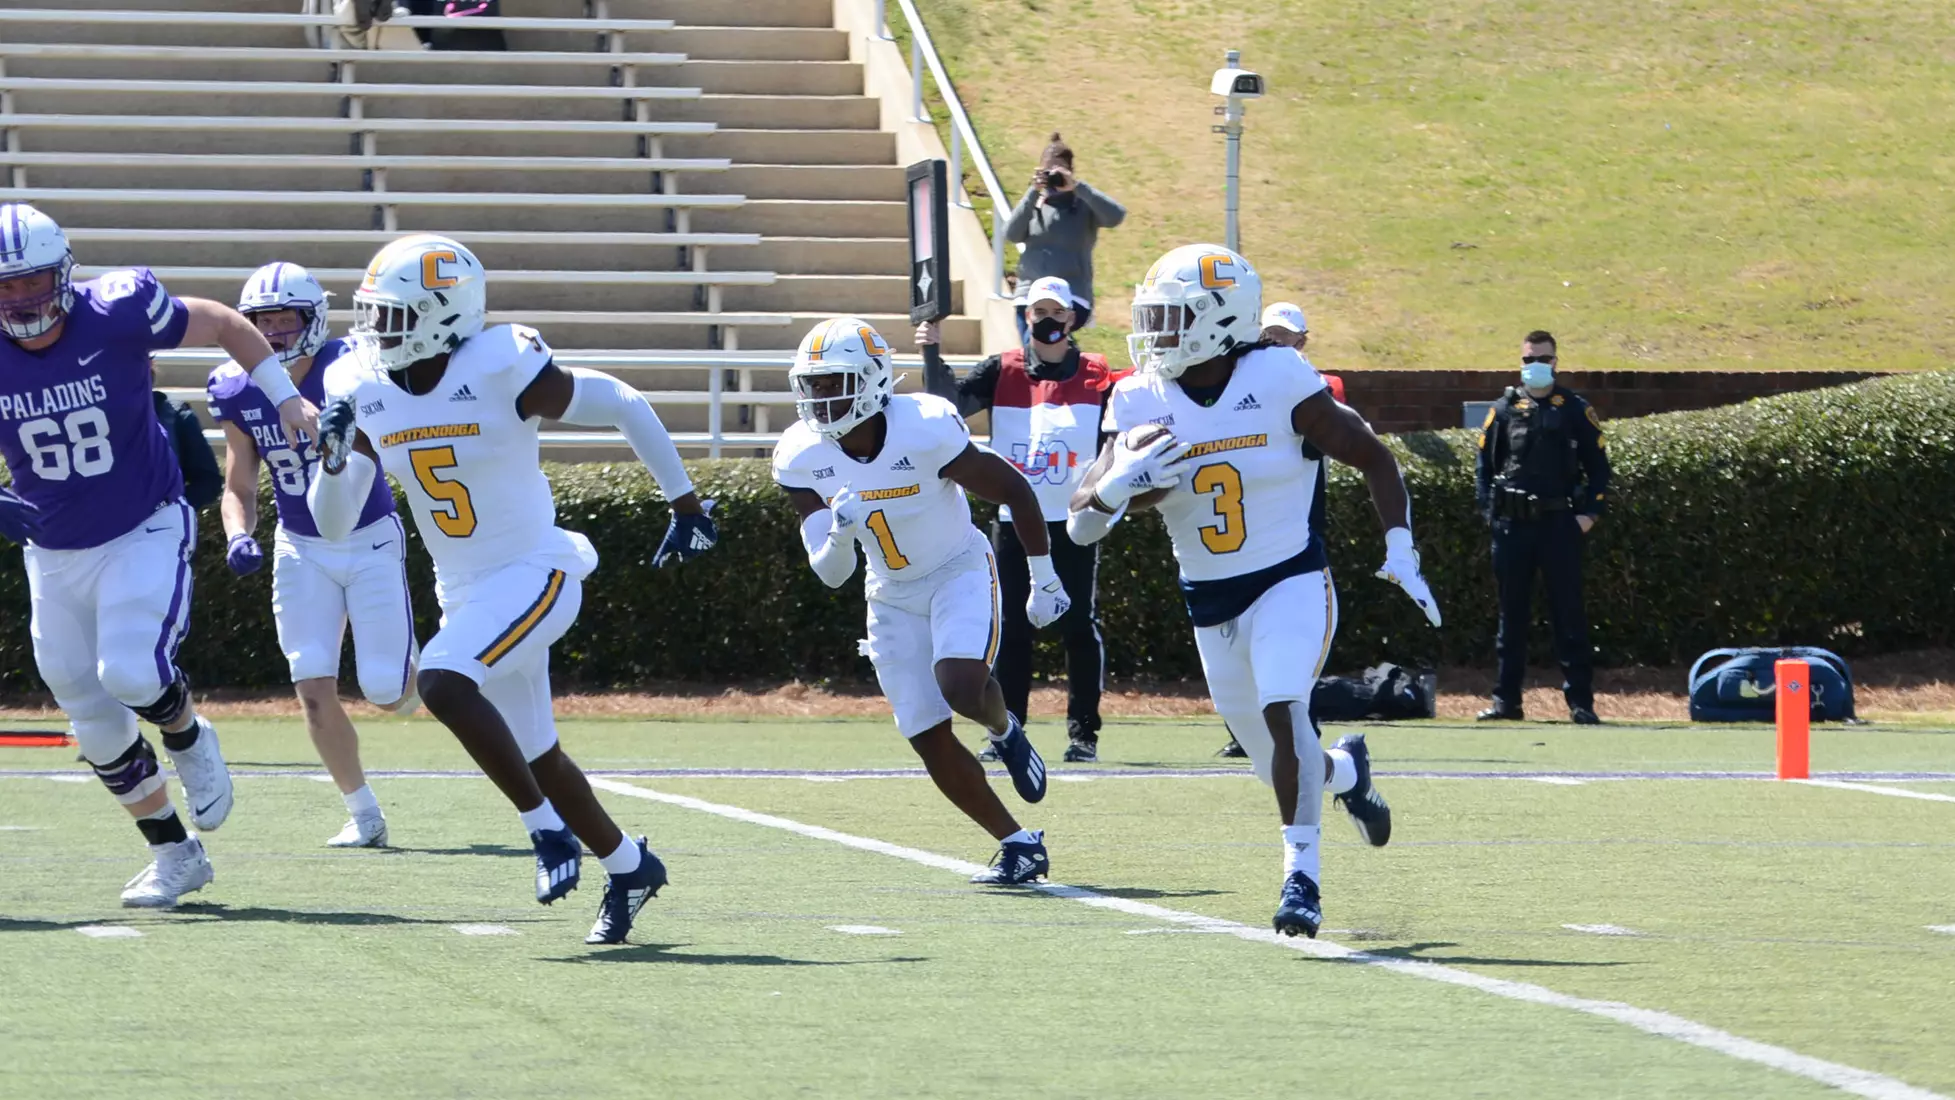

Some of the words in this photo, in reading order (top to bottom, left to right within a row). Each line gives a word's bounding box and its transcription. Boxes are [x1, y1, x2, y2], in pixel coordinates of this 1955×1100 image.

[420, 250, 459, 291] C
[1197, 254, 1236, 290] C
[0, 374, 107, 420] PALADINS
[18, 406, 114, 481] 68
[379, 423, 481, 448] CHATTANOOGA
[408, 444, 478, 538] 5
[812, 466, 835, 480] SOCON
[1191, 461, 1248, 555] 3
[865, 508, 911, 571] 1
